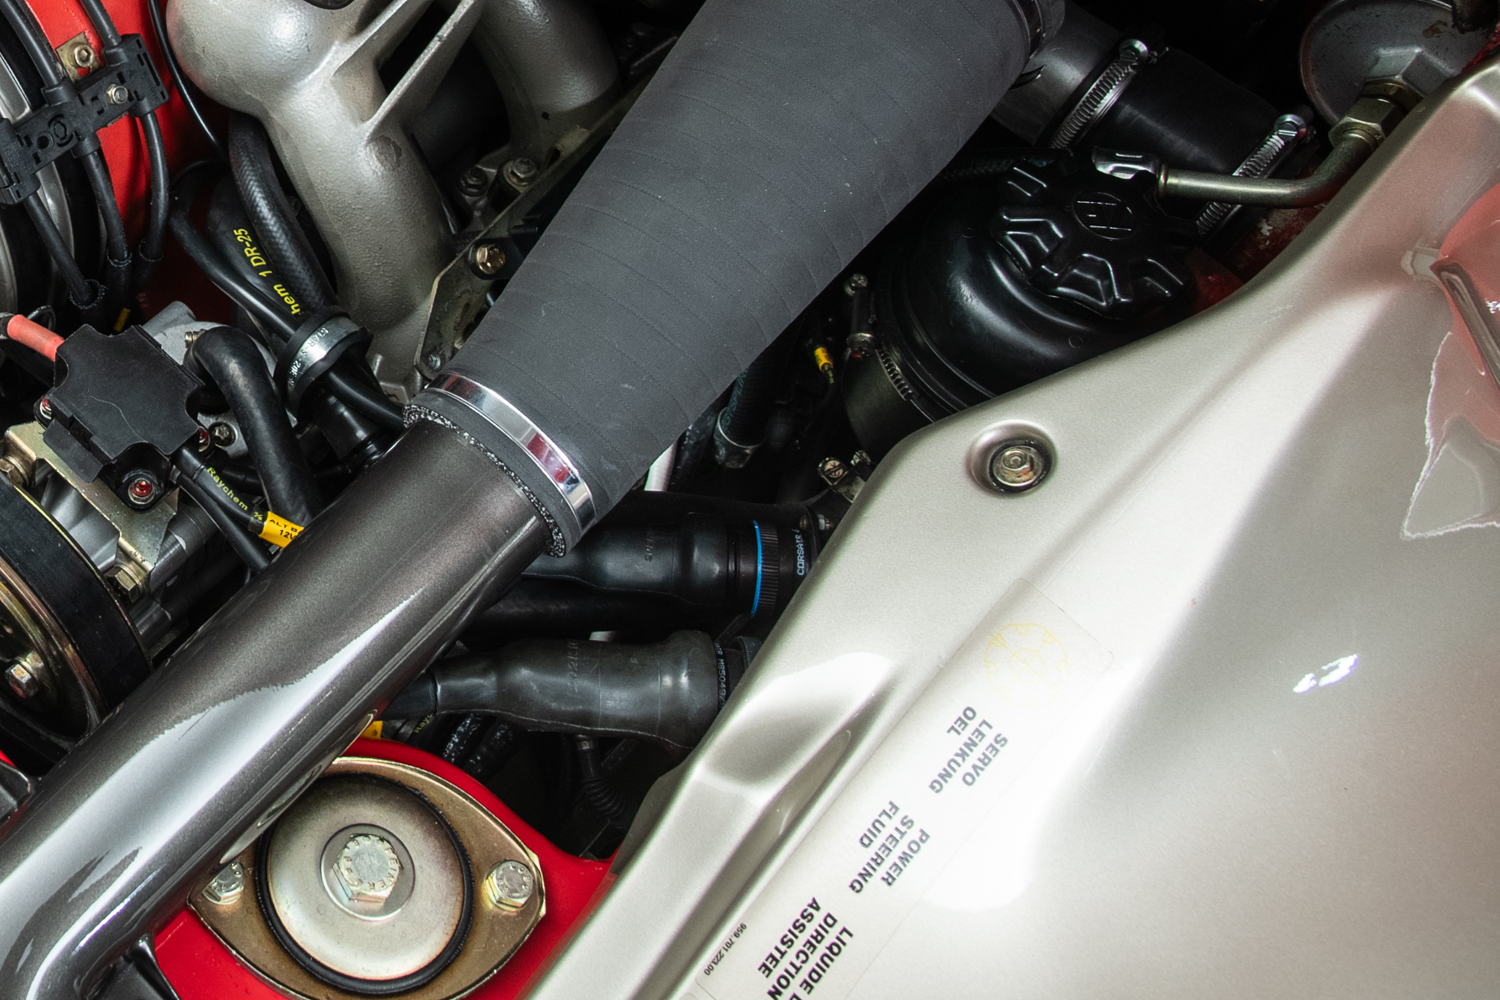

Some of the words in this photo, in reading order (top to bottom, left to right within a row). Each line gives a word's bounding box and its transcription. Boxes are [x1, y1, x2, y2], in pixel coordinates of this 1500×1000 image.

[232, 226, 266, 268] DR-25
[258, 268, 272, 277] 1
[272, 281, 303, 317] hem
[206, 467, 249, 510] Raychem
[269, 518, 288, 528] ALT
[794, 534, 804, 575] CORSAIR
[947, 707, 977, 737] OEL
[929, 720, 993, 794] LENKUNG
[962, 734, 1008, 786] SERVO
[859, 801, 899, 849] FLUID
[849, 816, 914, 894] STEERING
[881, 829, 930, 886] POWER
[704, 923, 747, 976] 959.701.223.00
[758, 898, 821, 979] ASSISTEE
[767, 913, 837, 1000] DIRECTION
[798, 925, 854, 995] LIQUIDE
